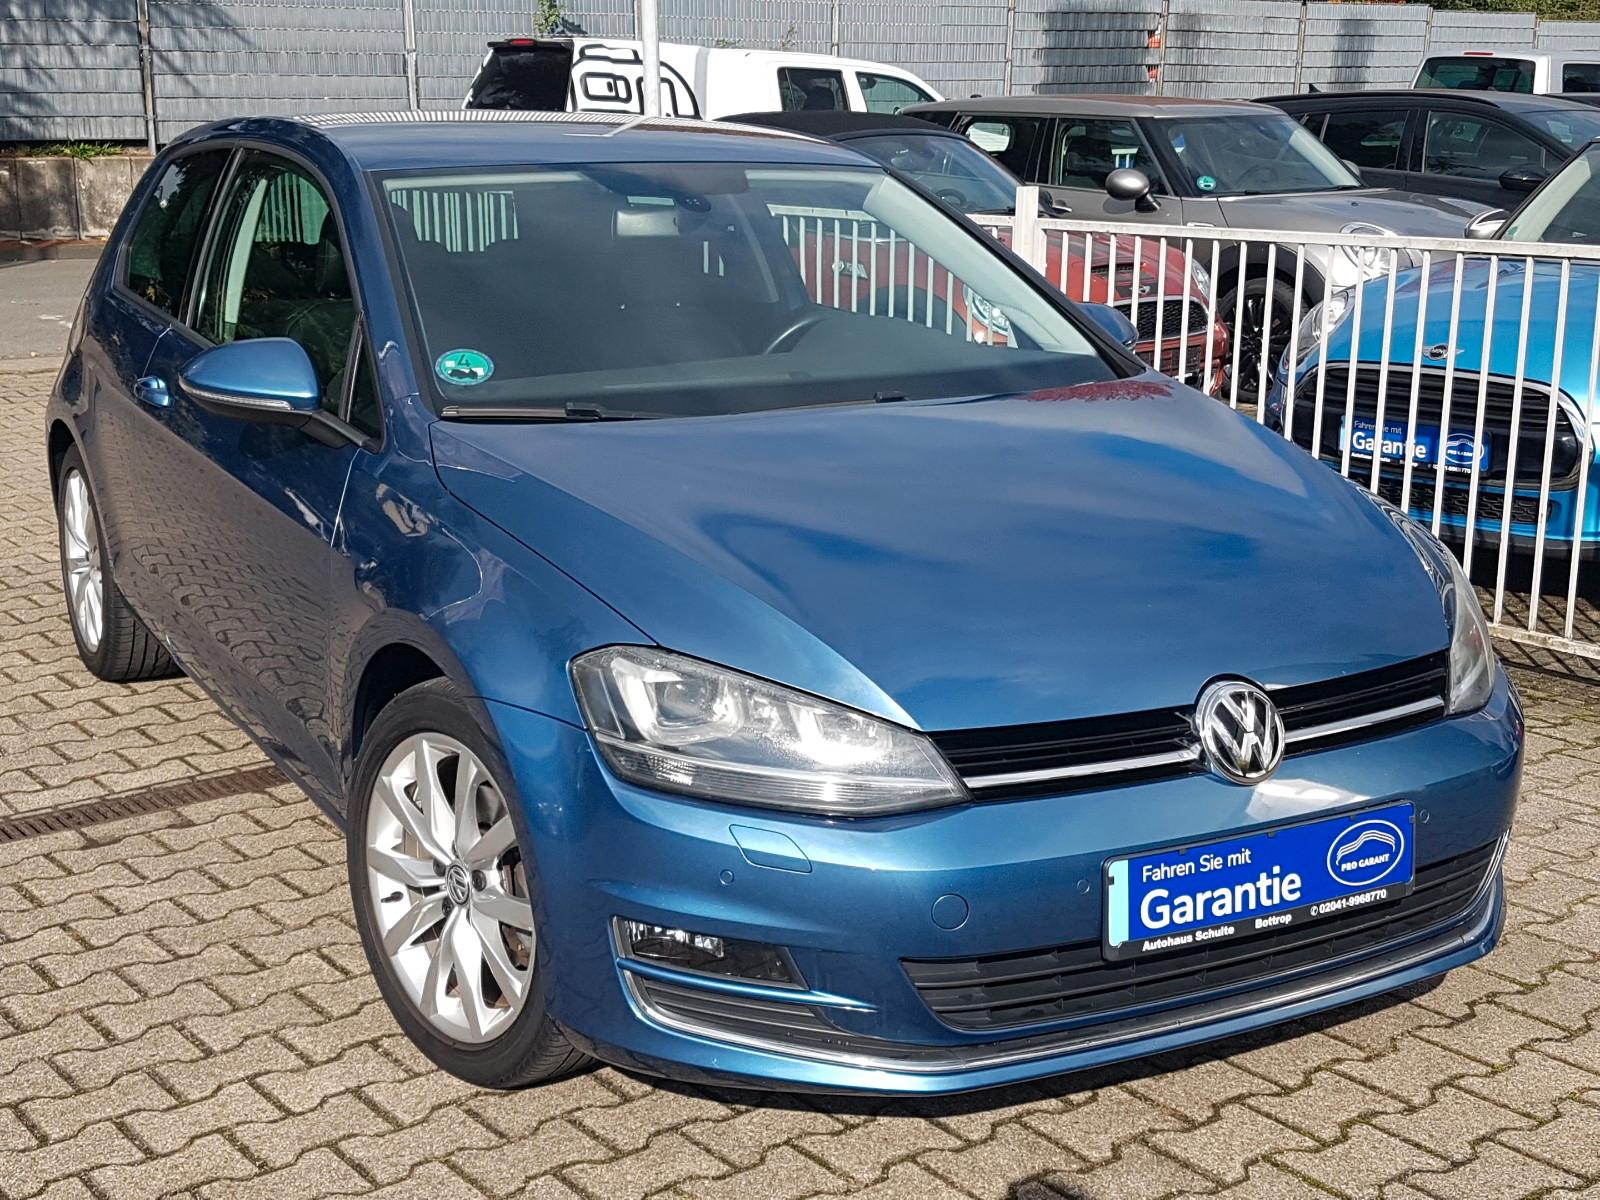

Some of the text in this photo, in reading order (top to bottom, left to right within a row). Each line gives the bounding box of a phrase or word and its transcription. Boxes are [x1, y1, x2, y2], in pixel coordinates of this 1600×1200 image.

[457, 354, 471, 367] 4
[1142, 848, 1252, 882] Fahren Sie mit
[1341, 853, 1390, 872] PRO GARANT
[1140, 866, 1301, 929] Garantie
[1142, 934, 1193, 951] Autohaus
[1195, 926, 1235, 942] Schulte
[1254, 914, 1292, 929] Bottrop
